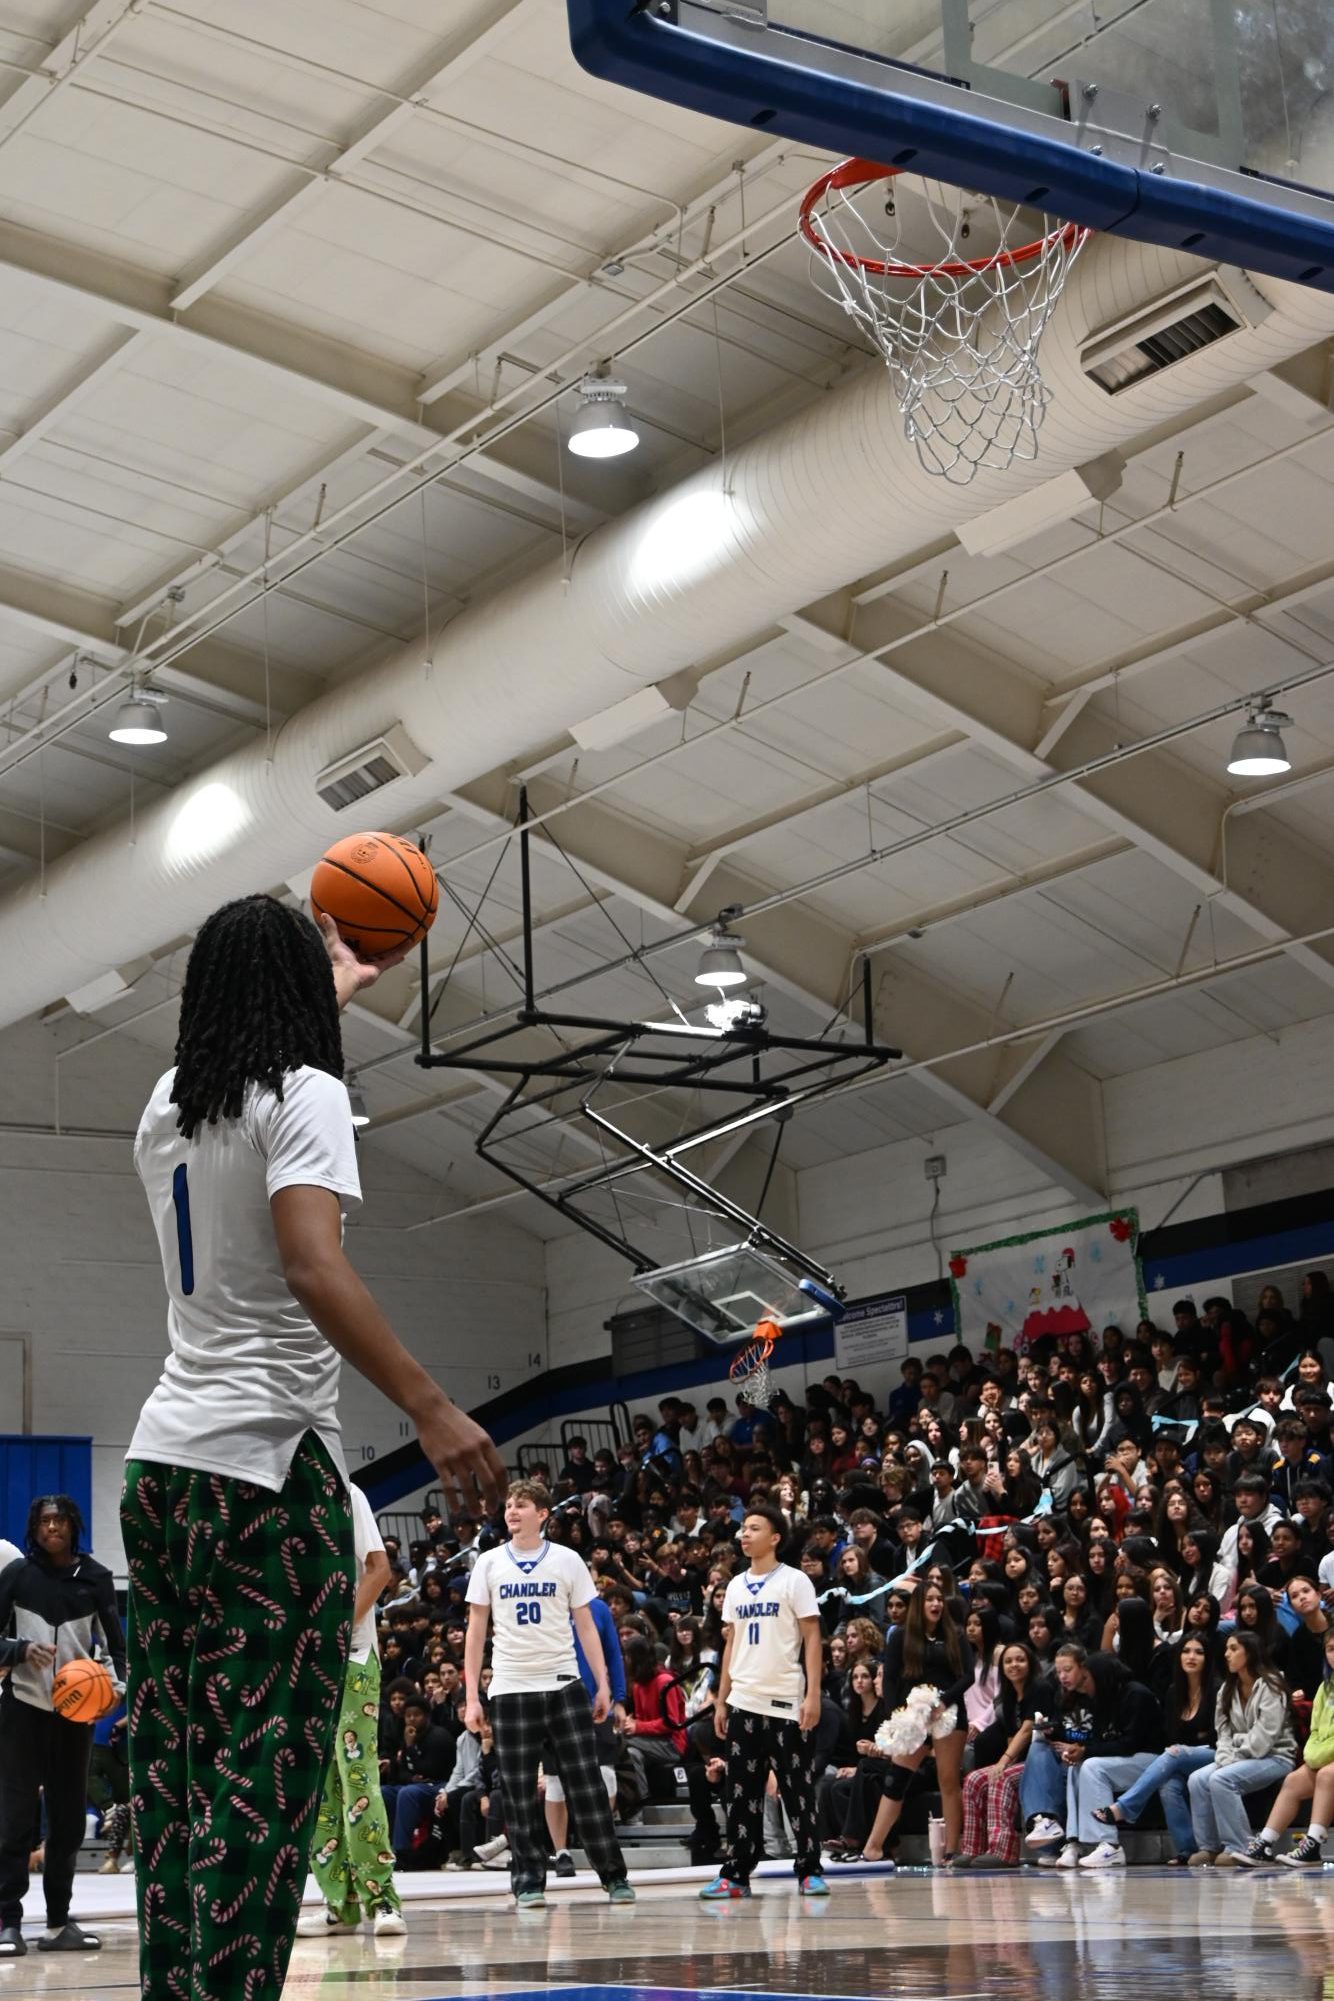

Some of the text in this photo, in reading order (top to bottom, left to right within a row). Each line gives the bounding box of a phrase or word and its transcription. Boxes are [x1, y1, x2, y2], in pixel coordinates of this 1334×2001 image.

[173, 1162, 195, 1296] 1
[528, 1353, 541, 1368] 14
[488, 1375, 501, 1390] 13
[400, 1422, 409, 1437] 11
[361, 1446, 375, 1461] 10
[500, 1583, 556, 1599] CHANDLER
[516, 1602, 541, 1625] 20
[736, 1602, 780, 1619] HANDLER
[748, 1622, 760, 1645] 11
